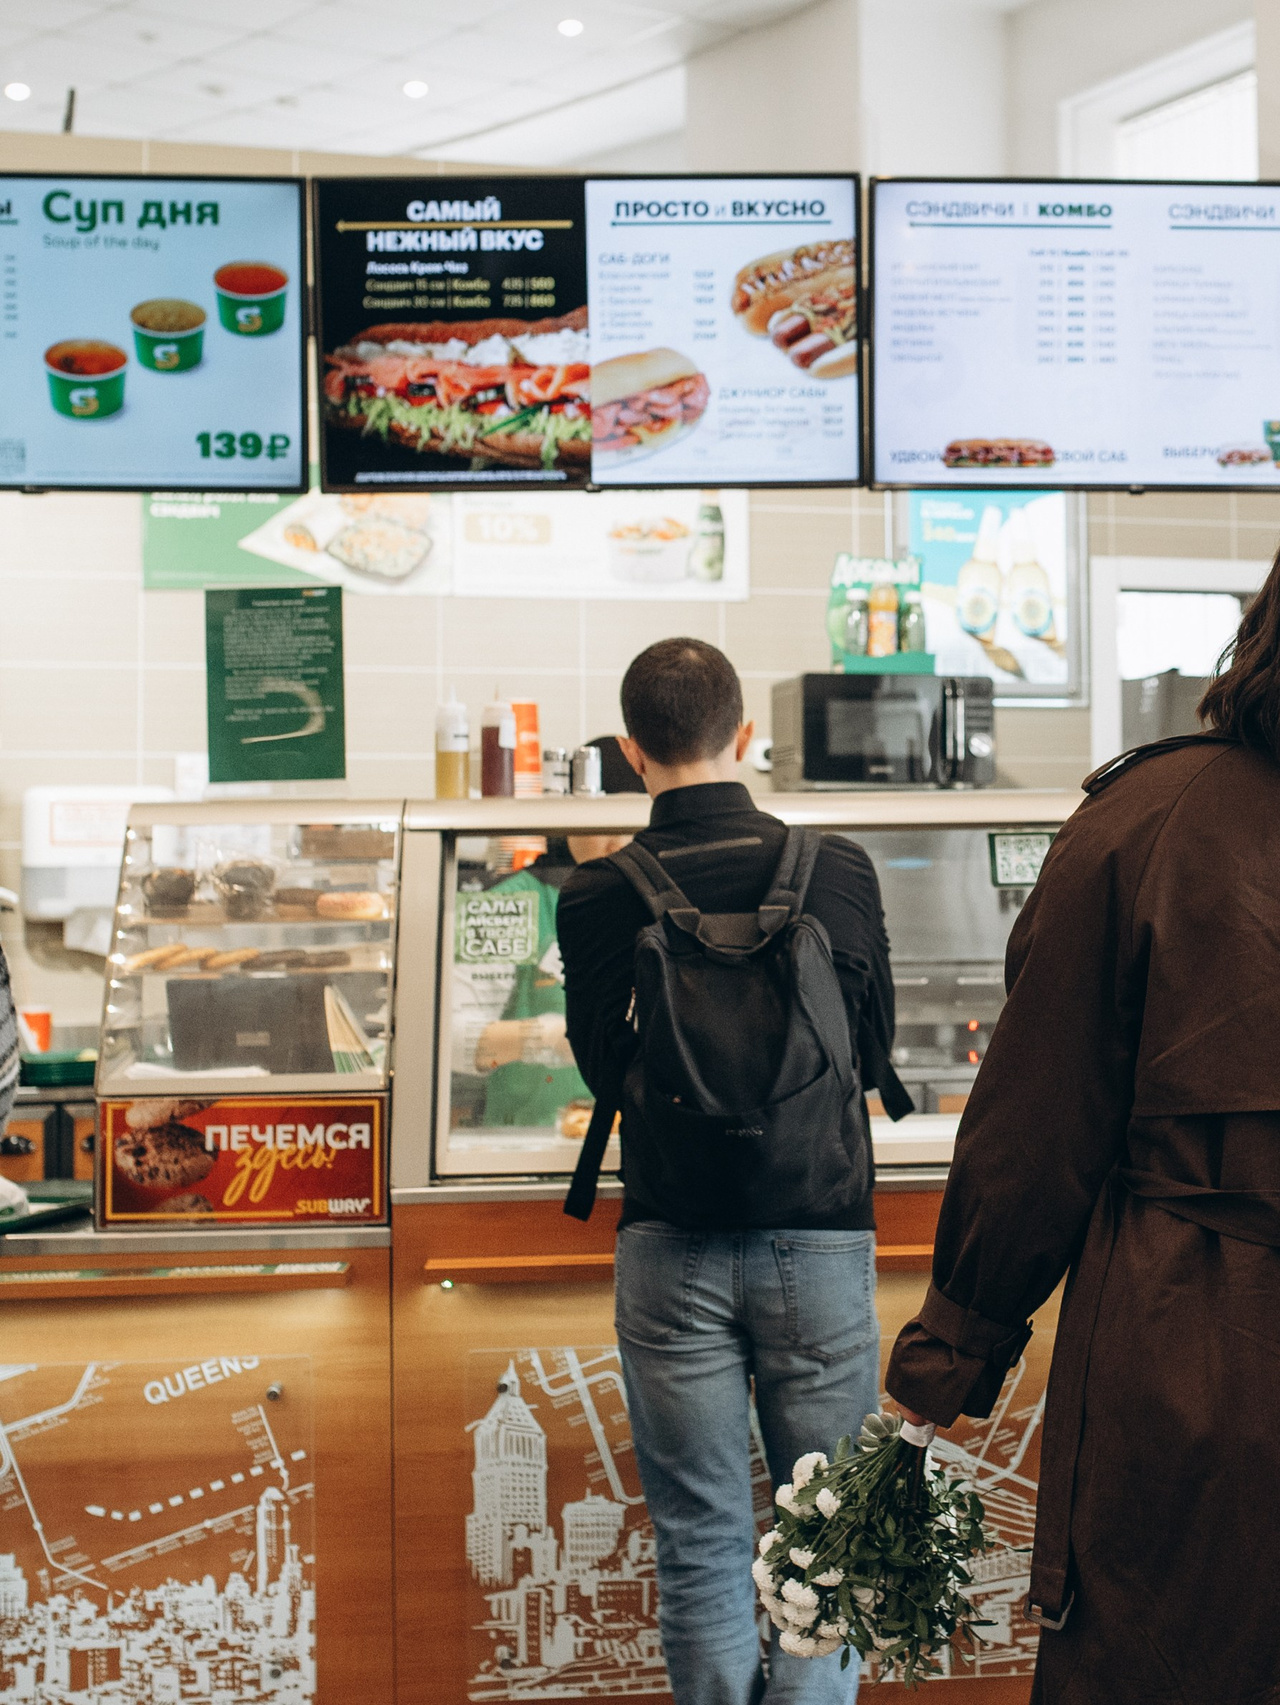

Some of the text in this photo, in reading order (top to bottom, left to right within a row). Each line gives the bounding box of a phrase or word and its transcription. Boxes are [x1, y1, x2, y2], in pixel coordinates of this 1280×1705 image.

[42, 188, 220, 233] Суп дня
[406, 196, 502, 222] САМЫЙ
[615, 201, 710, 218] ПРОСТО
[731, 200, 826, 218] ВКУСНО
[905, 200, 1113, 218] СЭНДВИЧИ КОМБО
[1168, 203, 1275, 221] СЭНДВИЧИ
[43, 233, 160, 251] Soup of the day
[365, 226, 545, 252] НЕЖНЫЙ ВКУС
[195, 431, 291, 460] 139₽
[467, 900, 527, 915] САЛАТ
[466, 939, 527, 957] САБЕ
[205, 1122, 371, 1152] ПЕЧЕМСЯ
[295, 1197, 371, 1216] SUBWAY
[142, 1355, 261, 1406] QUEENS
